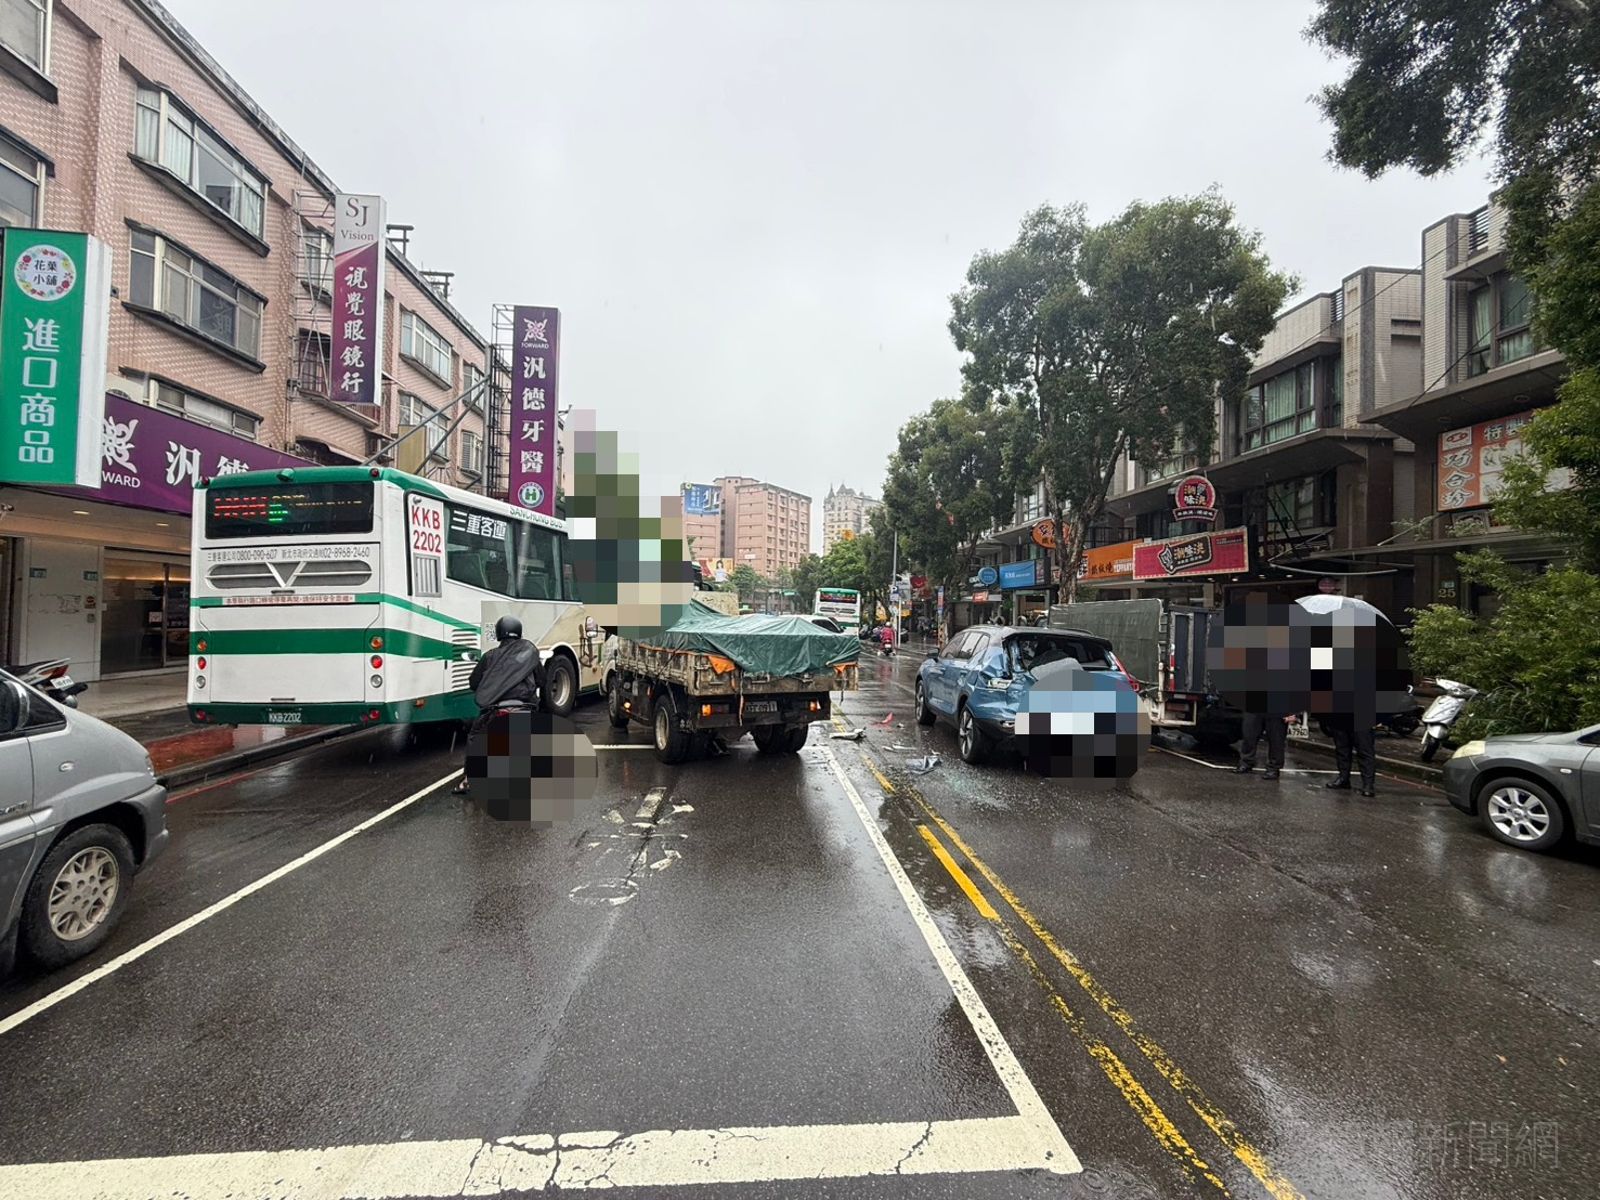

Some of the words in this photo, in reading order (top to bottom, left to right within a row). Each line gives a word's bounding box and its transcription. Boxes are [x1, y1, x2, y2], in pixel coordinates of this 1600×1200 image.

[345, 197, 368, 228] SJ
[340, 229, 374, 241] Vision
[340, 266, 368, 395] 視覺眼鏡行
[521, 342, 549, 350] FORWARD
[18, 317, 61, 464] 進口商品
[520, 355, 547, 474] 汎德牙醫
[411, 505, 441, 530] KKB
[451, 509, 507, 541] 三重客運
[412, 530, 442, 554] 2202
